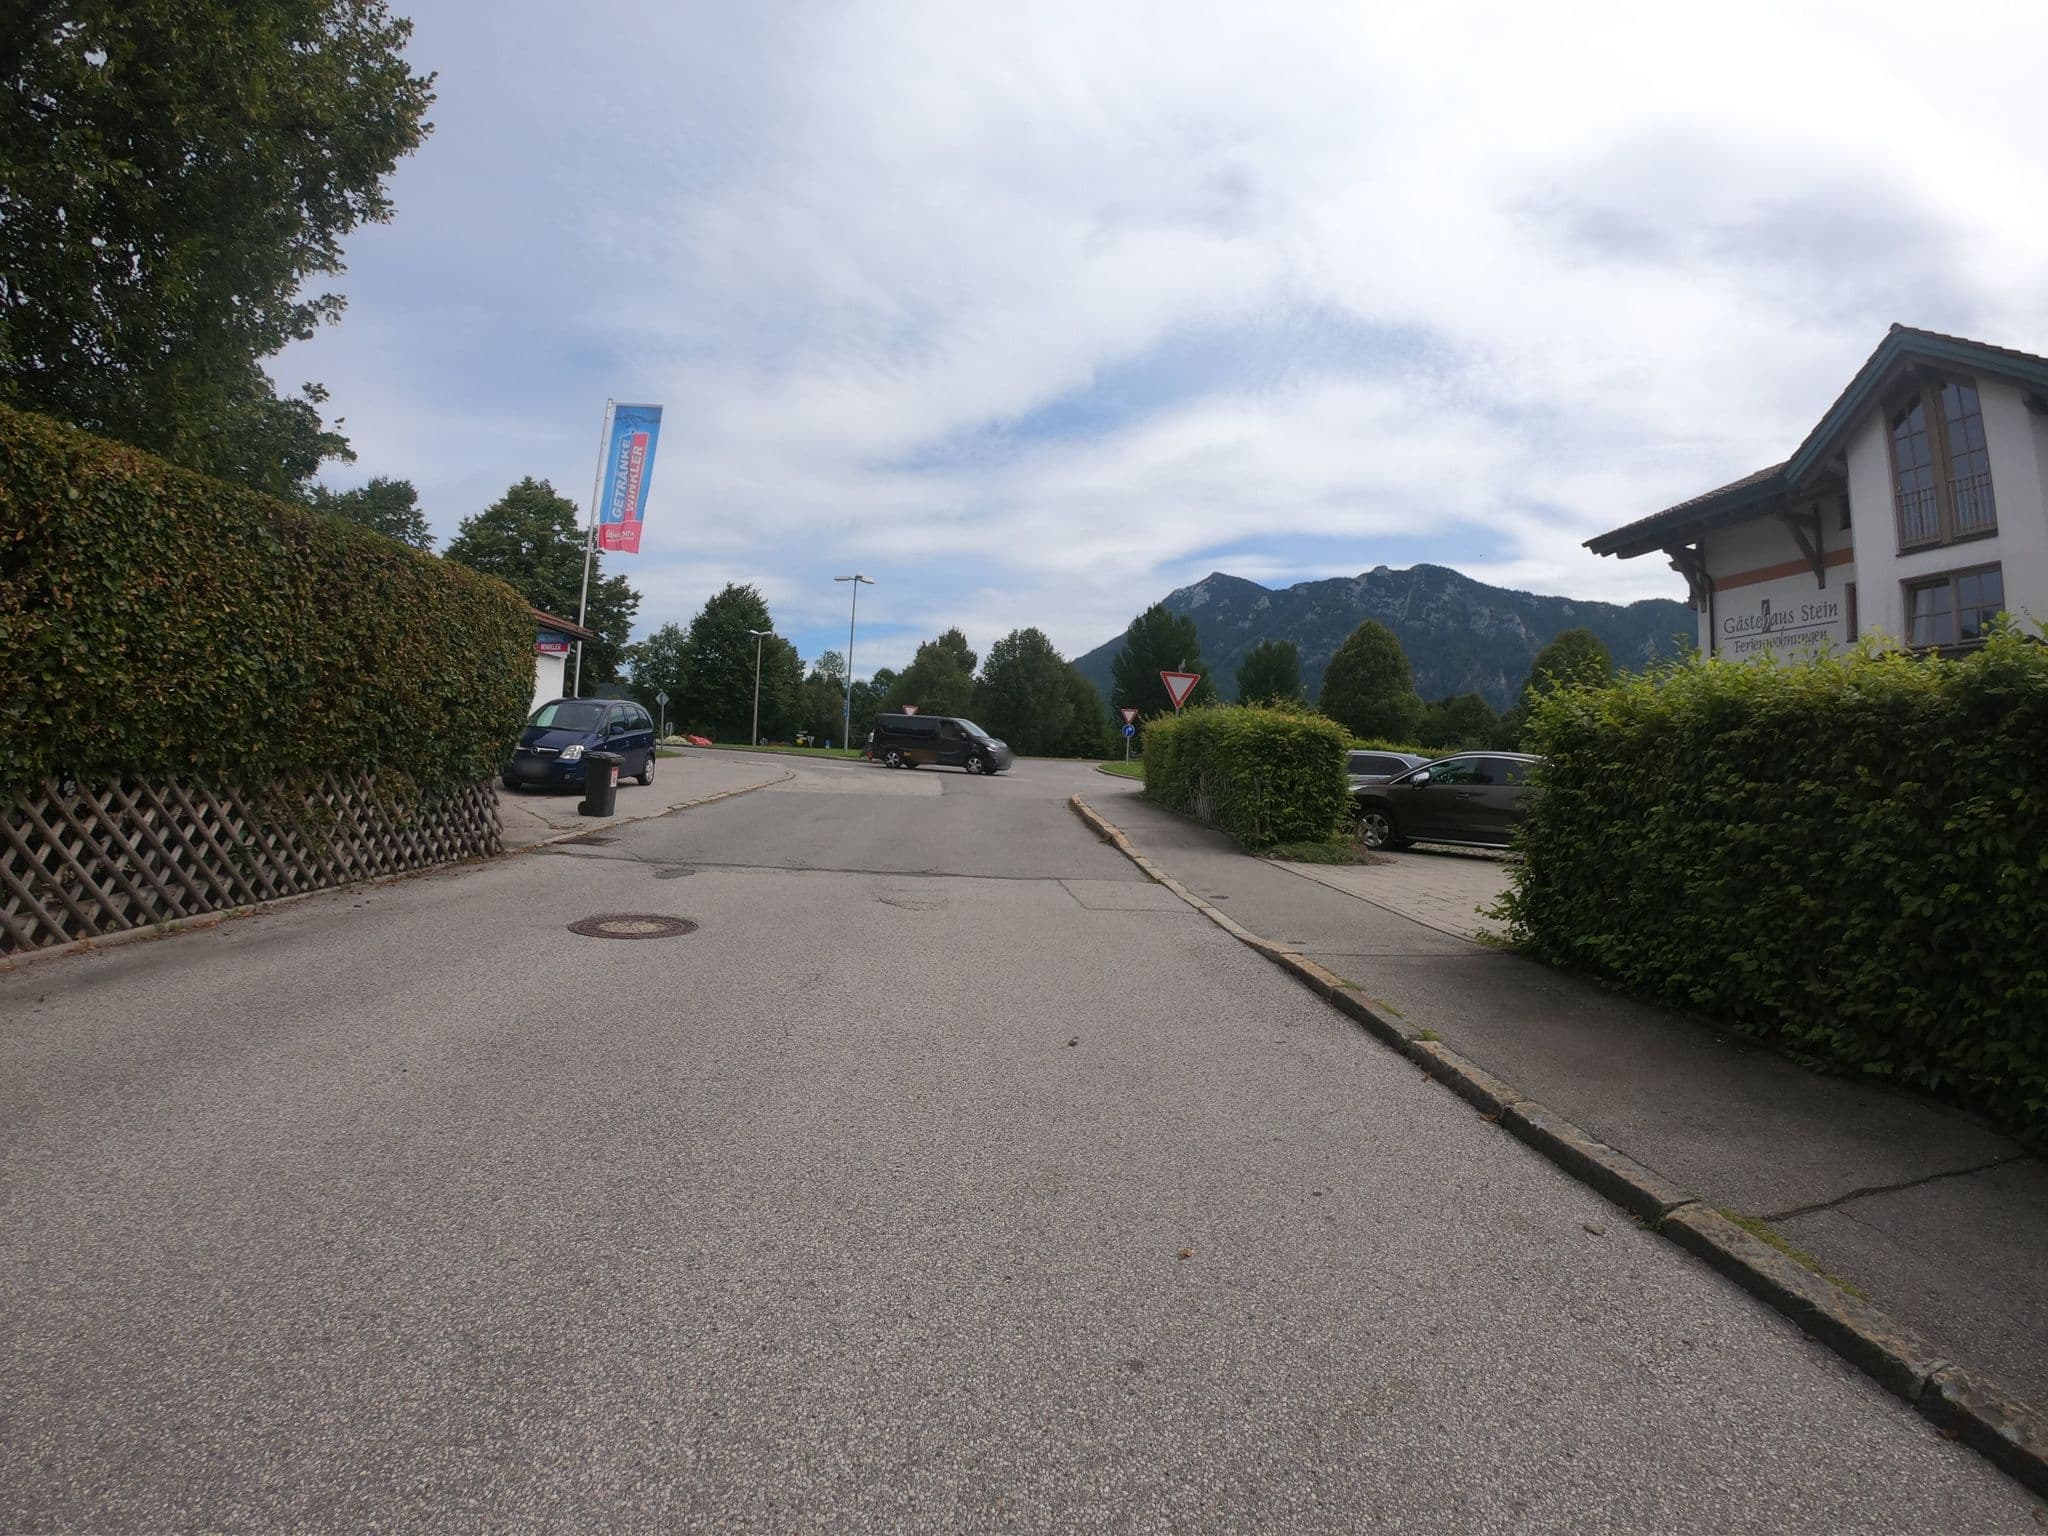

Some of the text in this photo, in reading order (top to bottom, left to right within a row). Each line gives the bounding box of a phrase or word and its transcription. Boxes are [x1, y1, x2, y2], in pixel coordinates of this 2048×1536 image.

[611, 438, 631, 520] GETRÄNKE
[625, 446, 644, 512] WINKLER
[1801, 600, 1838, 622] Stein
[1735, 627, 1828, 653] Ferienwohnungen
